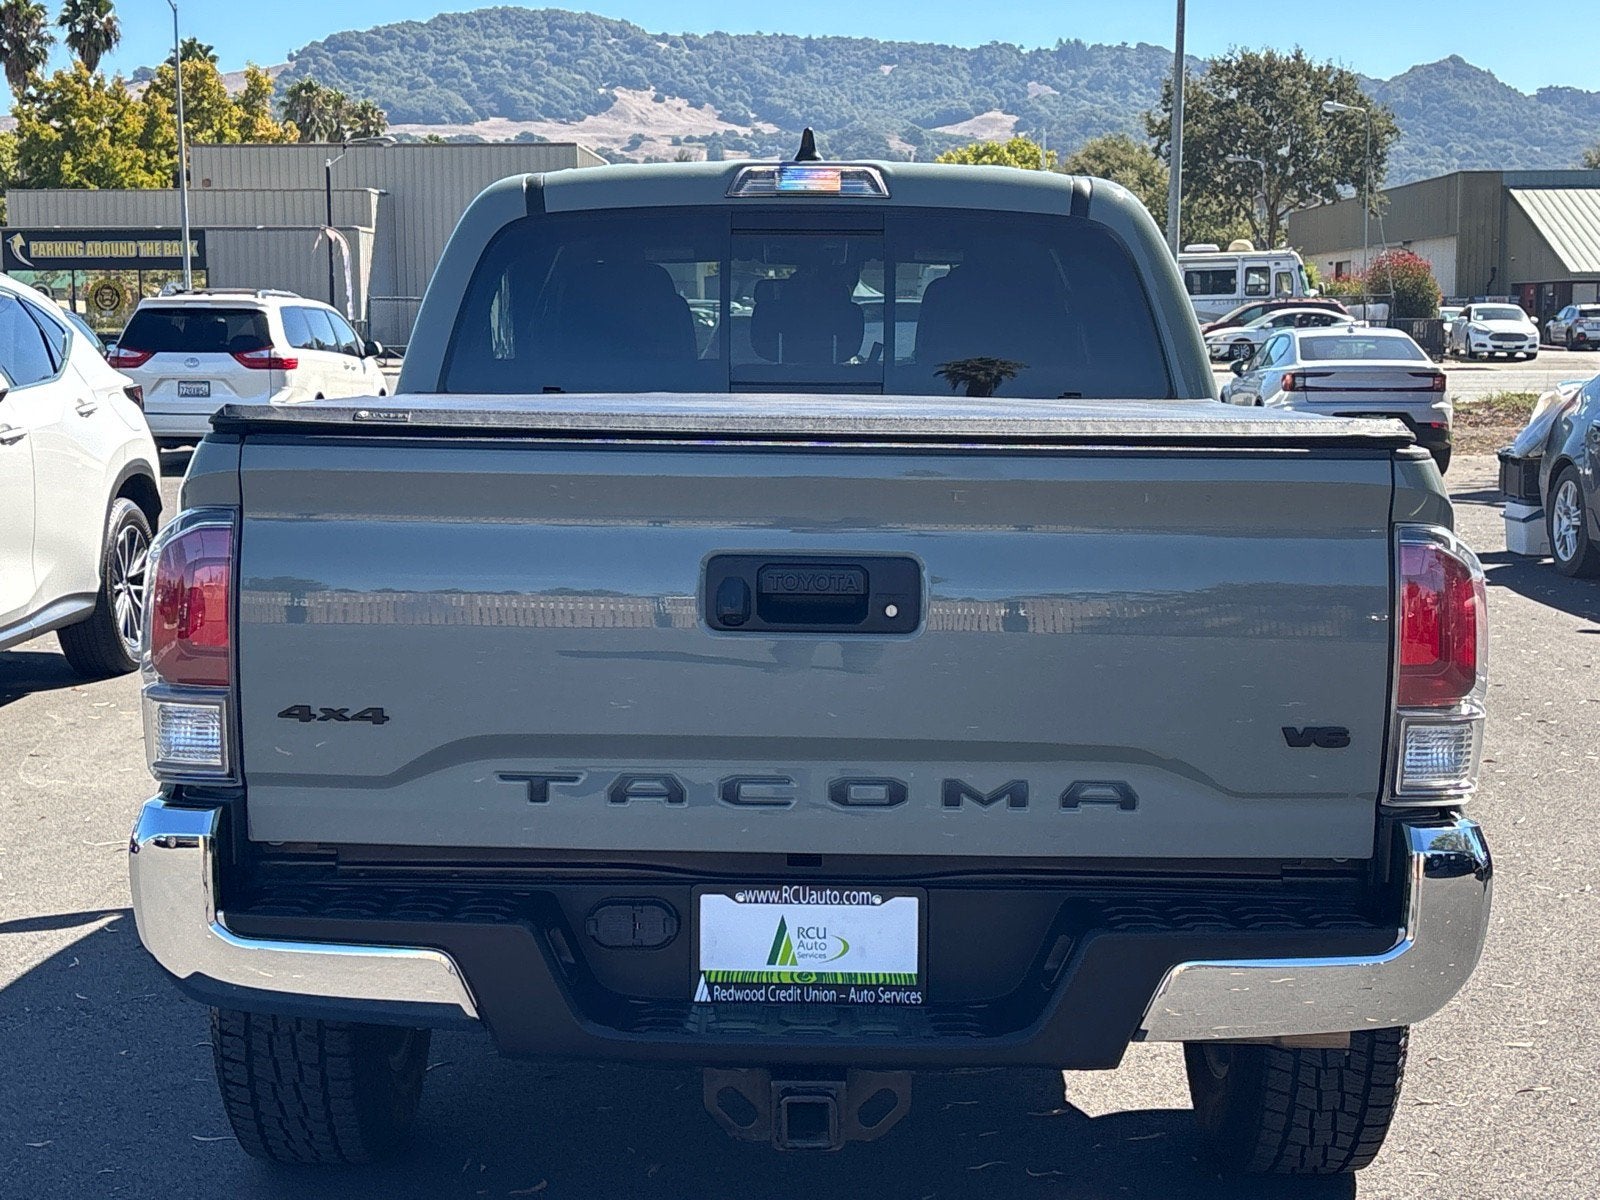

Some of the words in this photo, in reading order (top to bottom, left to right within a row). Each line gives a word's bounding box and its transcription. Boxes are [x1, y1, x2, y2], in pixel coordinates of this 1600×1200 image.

[30, 240, 83, 258] PARKING
[86, 240, 136, 258] AROUND
[138, 240, 162, 258] THE
[768, 573, 859, 592] TOYOTA
[277, 705, 390, 725] 4x4
[1281, 726, 1351, 749] V6
[494, 770, 1140, 813] TACOMA
[744, 885, 872, 905] www.RCUauto.com
[797, 926, 827, 939] RCU
[797, 940, 827, 951] Auto
[797, 951, 827, 959] Services
[713, 985, 766, 1002] Redwood
[768, 986, 801, 1002] Credit
[804, 986, 836, 1003] Union
[849, 987, 876, 1003] Auto
[878, 987, 923, 1004] Services
